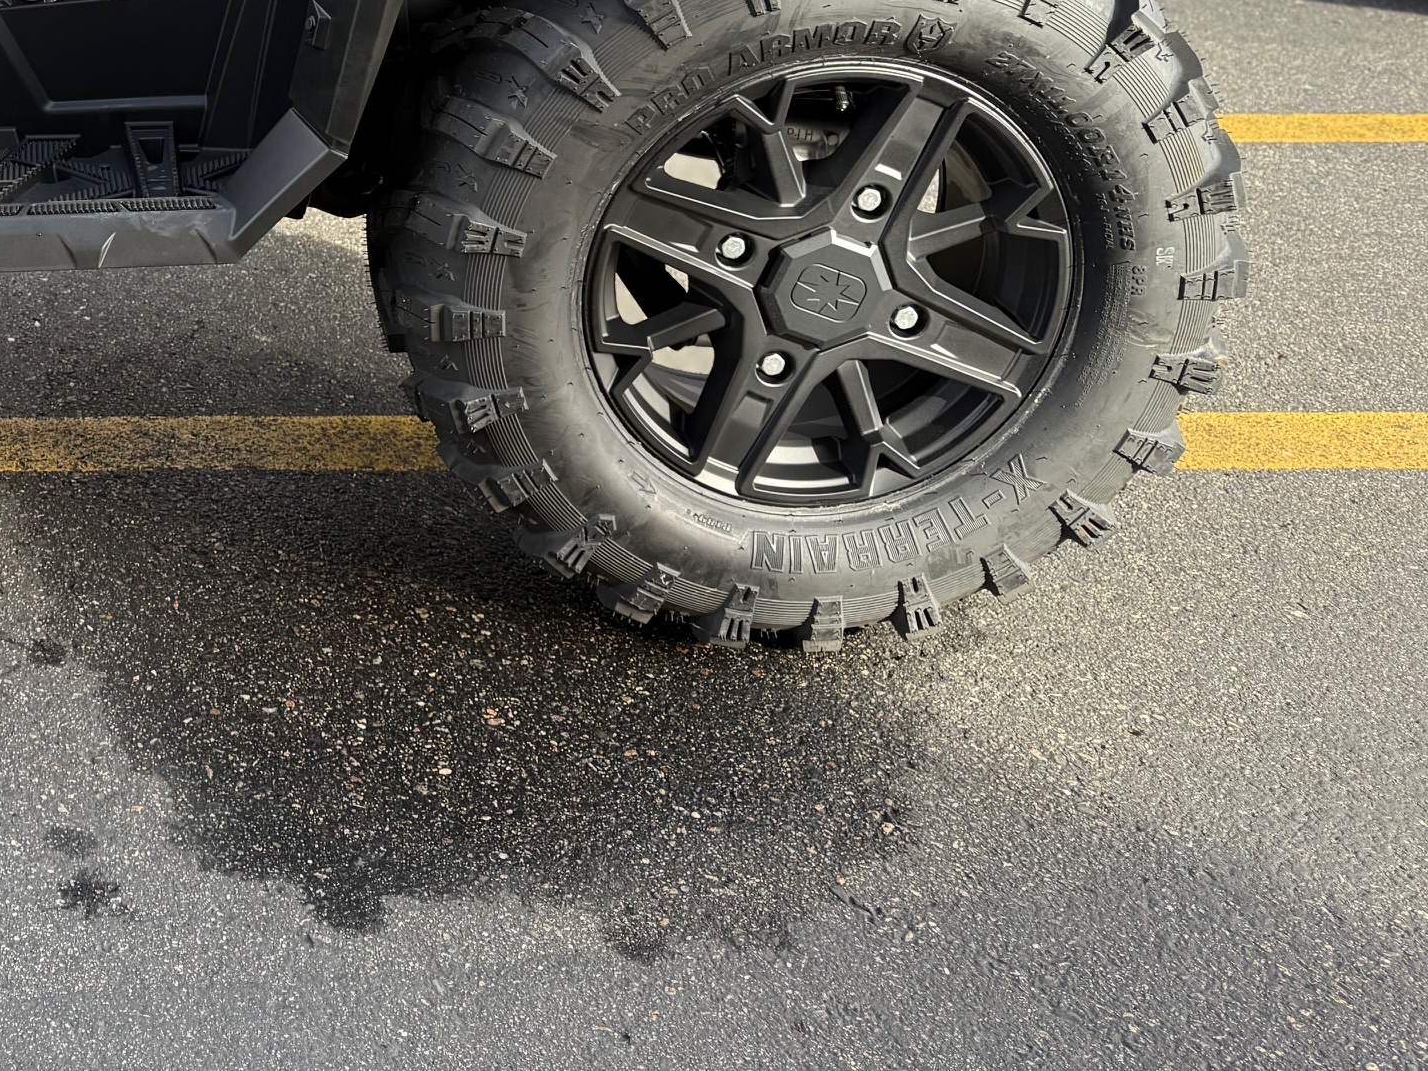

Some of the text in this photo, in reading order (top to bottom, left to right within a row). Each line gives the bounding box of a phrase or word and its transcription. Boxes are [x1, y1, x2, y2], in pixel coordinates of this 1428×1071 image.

[624, 17, 902, 135] PRO ARMOR
[1113, 206, 1136, 252] NHS
[750, 453, 1048, 574] X-TERRAIN
